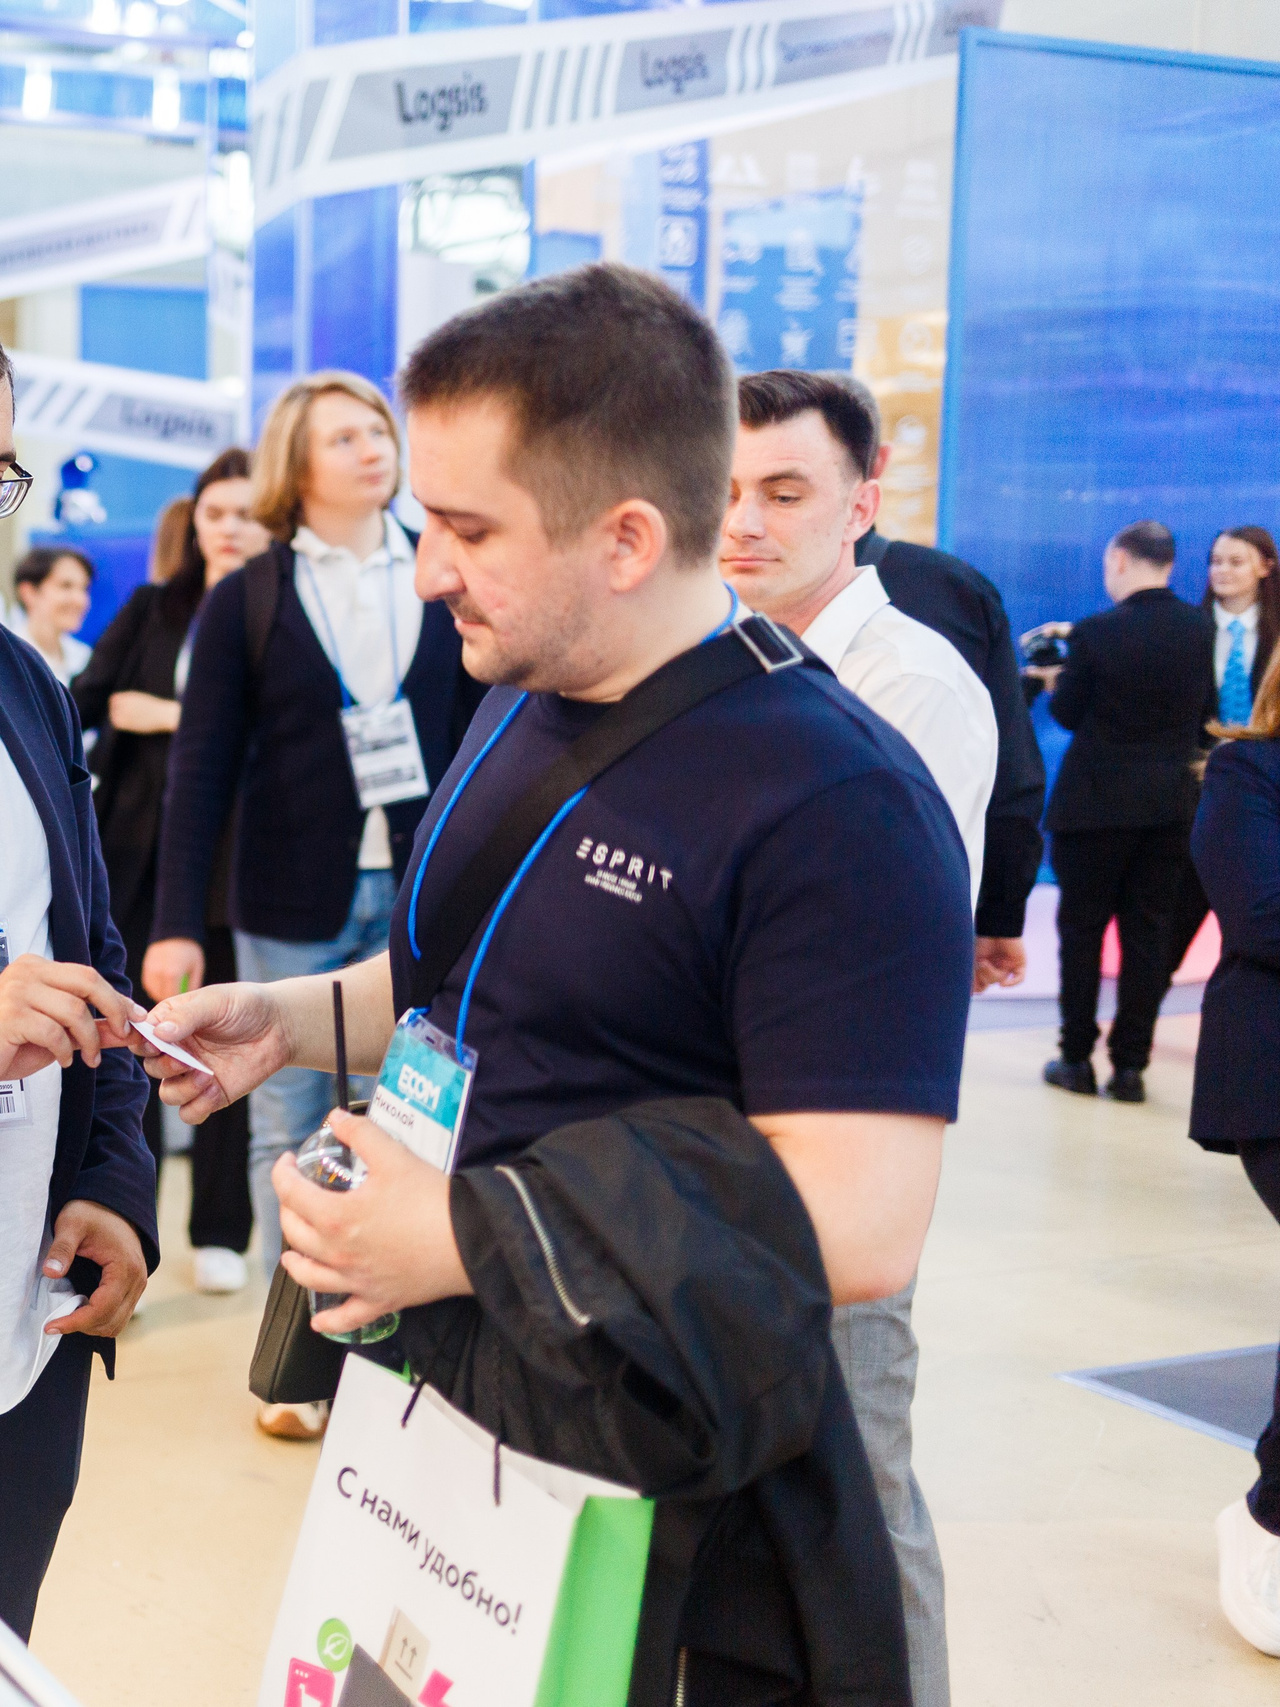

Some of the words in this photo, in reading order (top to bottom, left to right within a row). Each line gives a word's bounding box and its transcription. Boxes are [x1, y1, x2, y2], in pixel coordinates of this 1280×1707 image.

[639, 42, 709, 94] Logsis
[394, 72, 488, 132] Logsis
[576, 836, 673, 891] ESPRIT
[373, 1092, 415, 1128] Николай
[397, 1064, 441, 1109] ECOM
[337, 1466, 359, 1499] С
[360, 1488, 420, 1551] нами
[419, 1538, 524, 1635] удобно!
